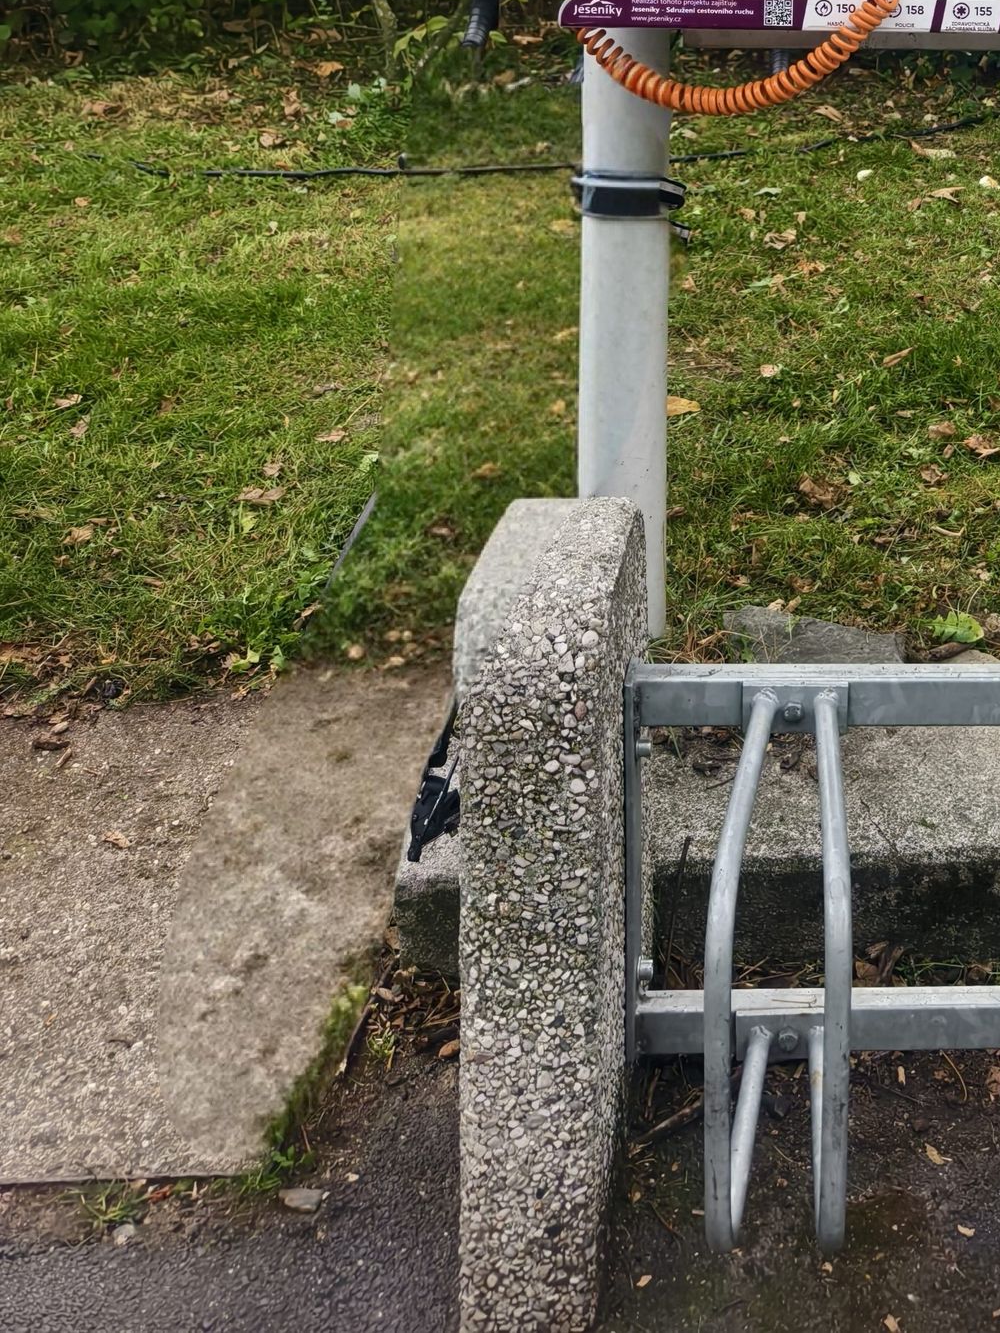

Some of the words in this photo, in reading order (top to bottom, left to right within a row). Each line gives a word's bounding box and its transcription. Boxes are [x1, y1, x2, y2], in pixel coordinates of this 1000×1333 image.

[683, 0, 710, 7] projektu
[711, 0, 737, 8] zajišťuje
[836, 4, 856, 14] 150
[573, 4, 623, 17] Jeseníky
[631, 6, 660, 15] Jeseníky
[666, 7, 695, 15] Sdružení
[697, 7, 734, 15] cestovního
[906, 5, 925, 15] 158
[974, 6, 993, 17] 155
[631, 15, 681, 23] www.jeseniky.cz
